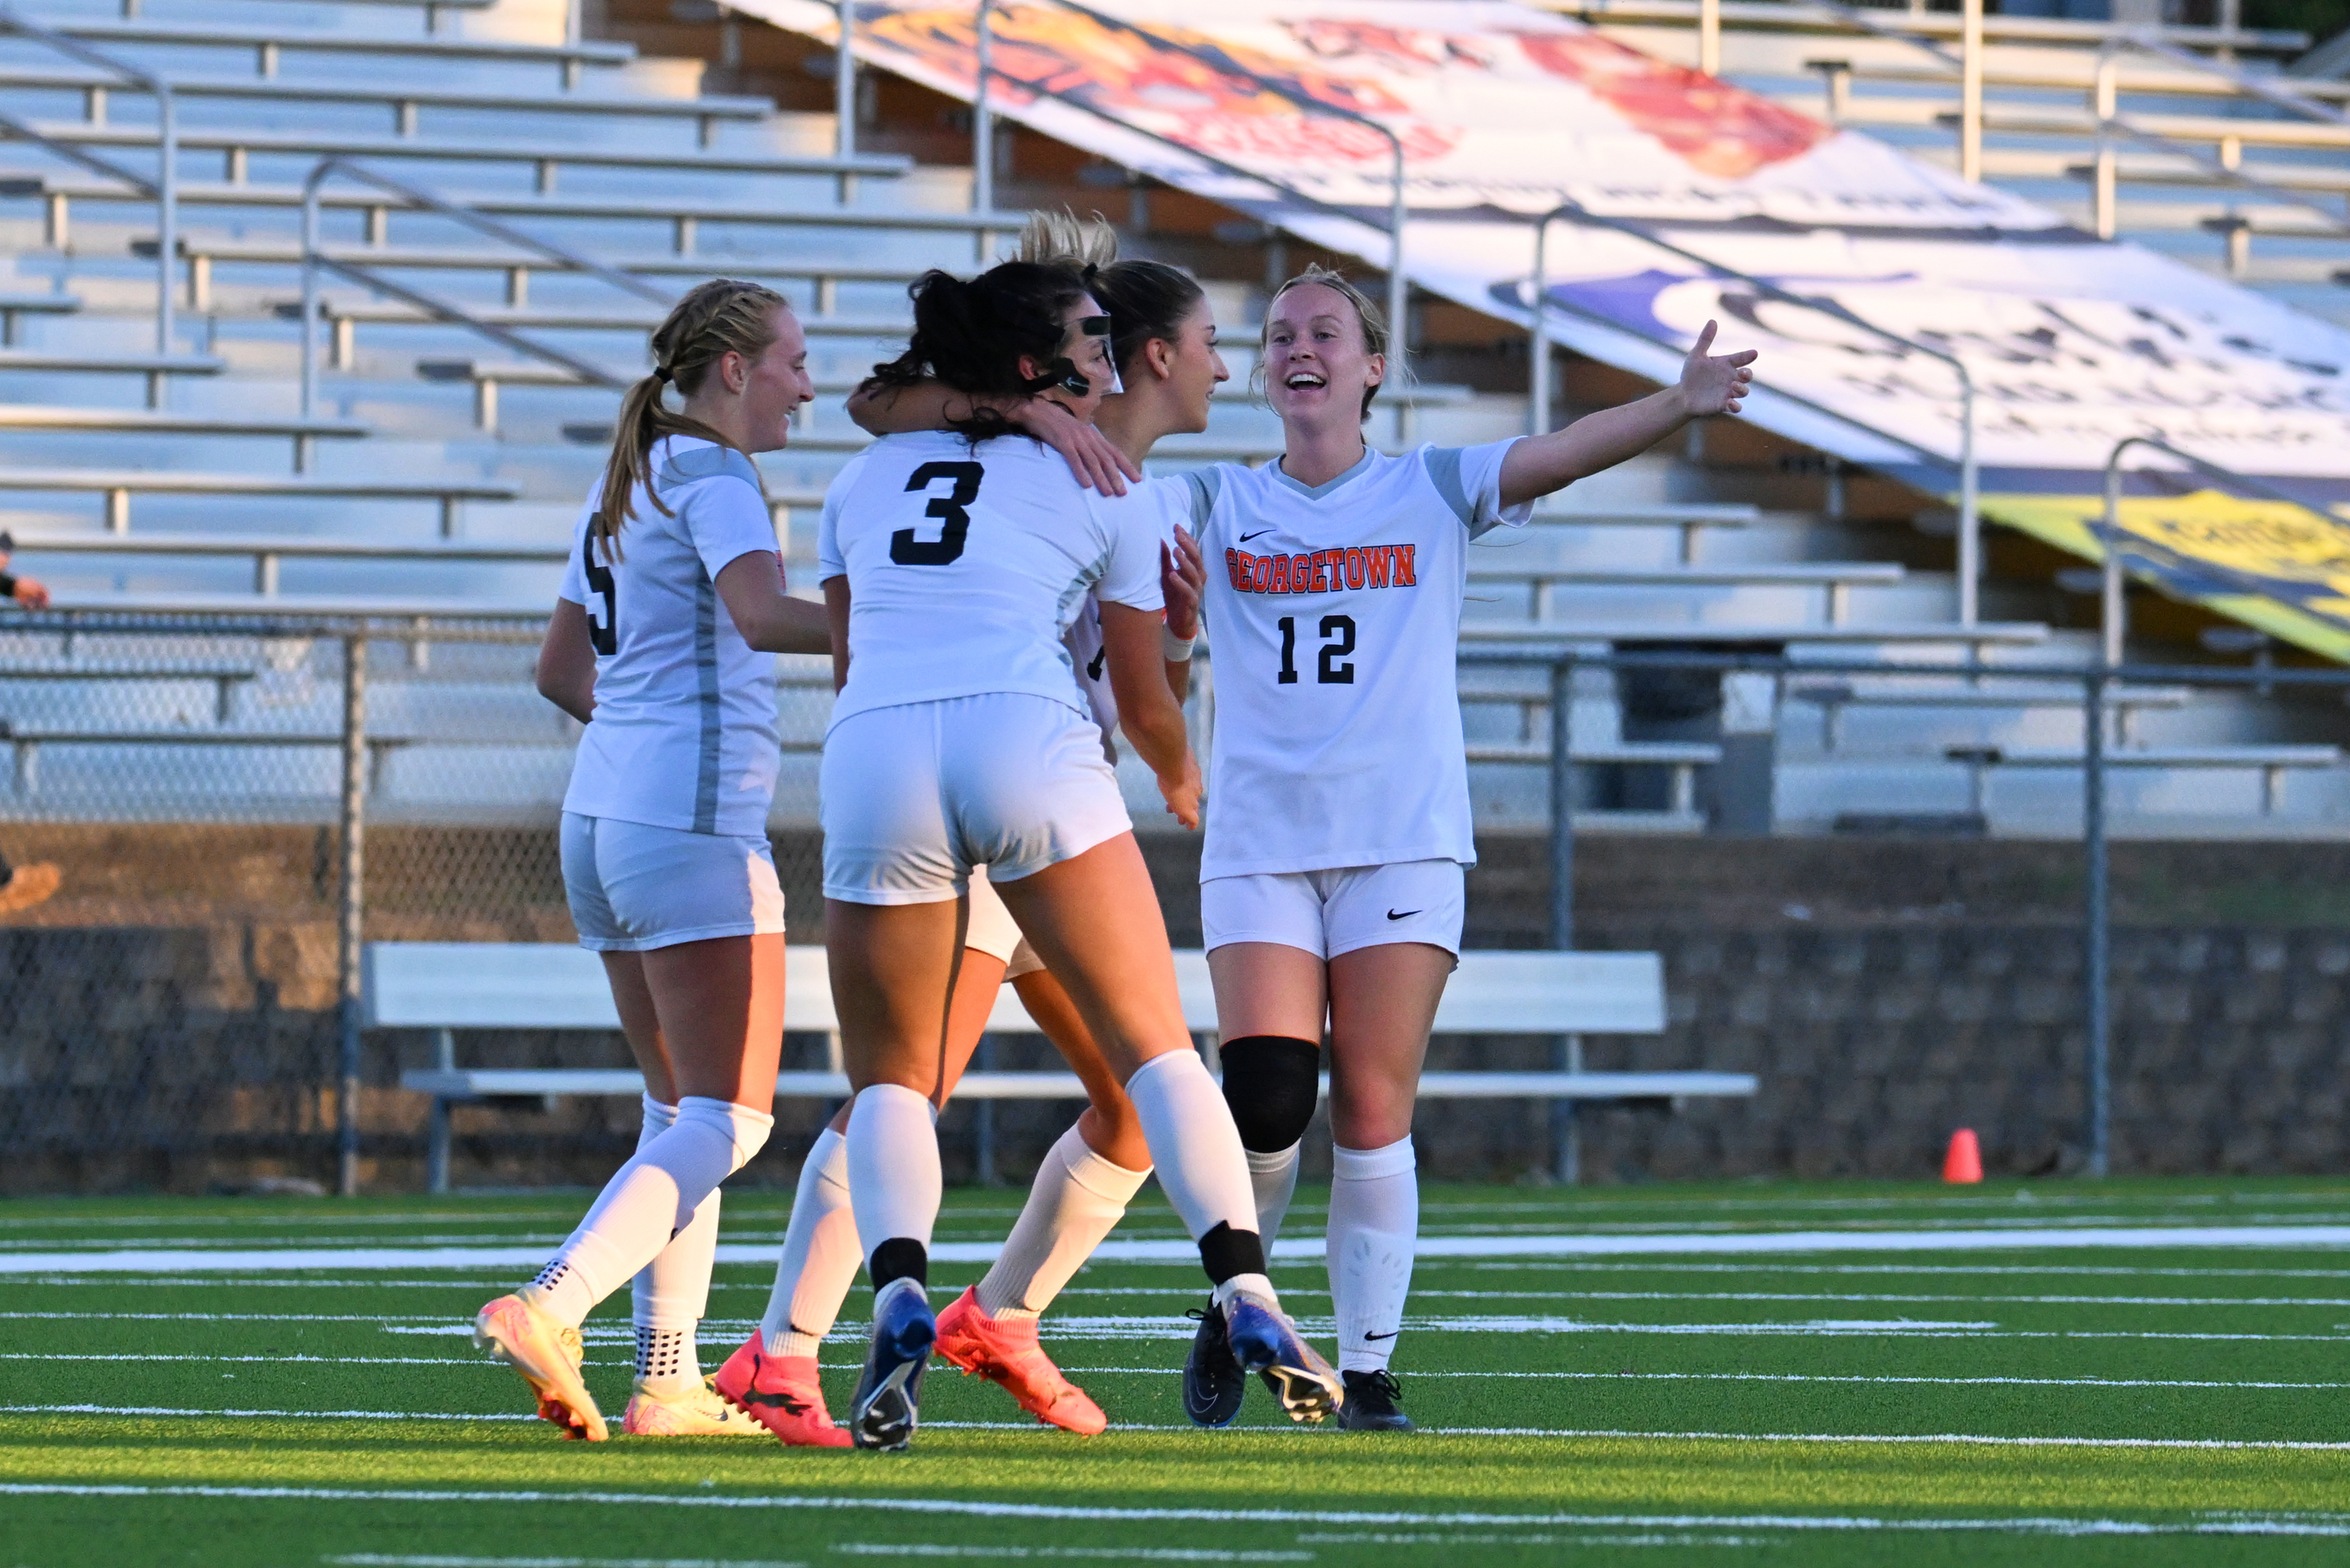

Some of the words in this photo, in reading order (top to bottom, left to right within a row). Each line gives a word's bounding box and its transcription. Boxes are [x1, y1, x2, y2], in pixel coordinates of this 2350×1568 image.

[889, 461, 985, 565] 3
[1225, 544, 1416, 593] GEORGETOWN
[1278, 615, 1356, 684] 12
